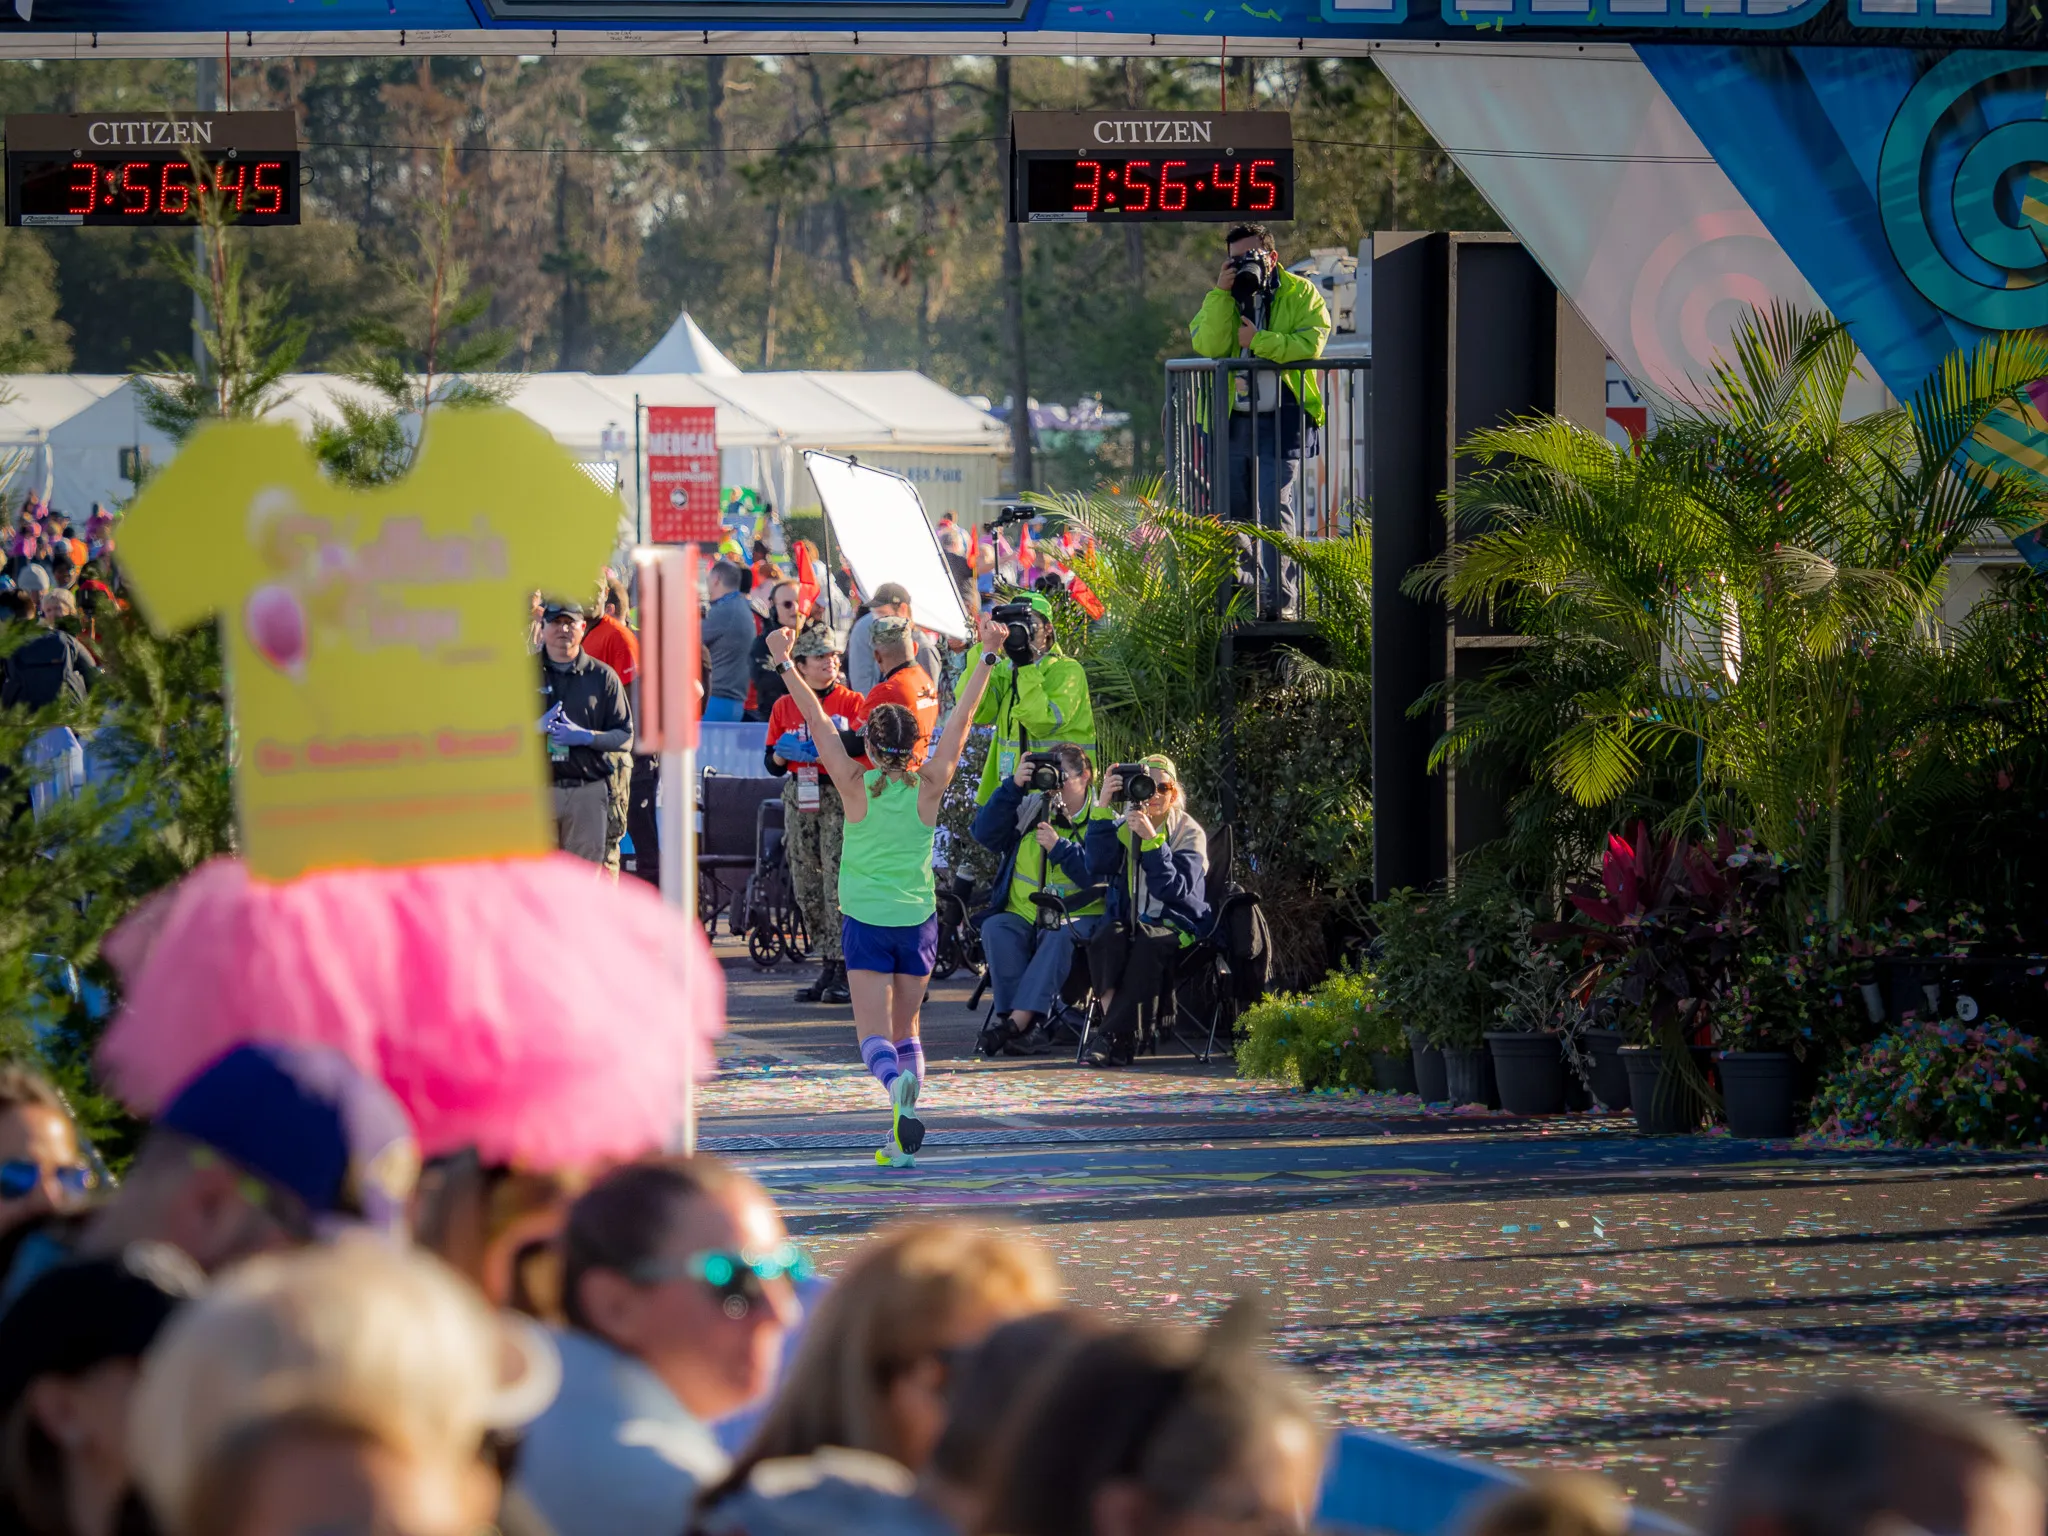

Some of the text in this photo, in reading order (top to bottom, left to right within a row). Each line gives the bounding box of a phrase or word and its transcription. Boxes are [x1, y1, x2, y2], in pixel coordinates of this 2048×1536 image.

[88, 121, 213, 146] CITIZEN
[1093, 120, 1212, 144] CITIZEN
[649, 432, 716, 456] MEDICAL
